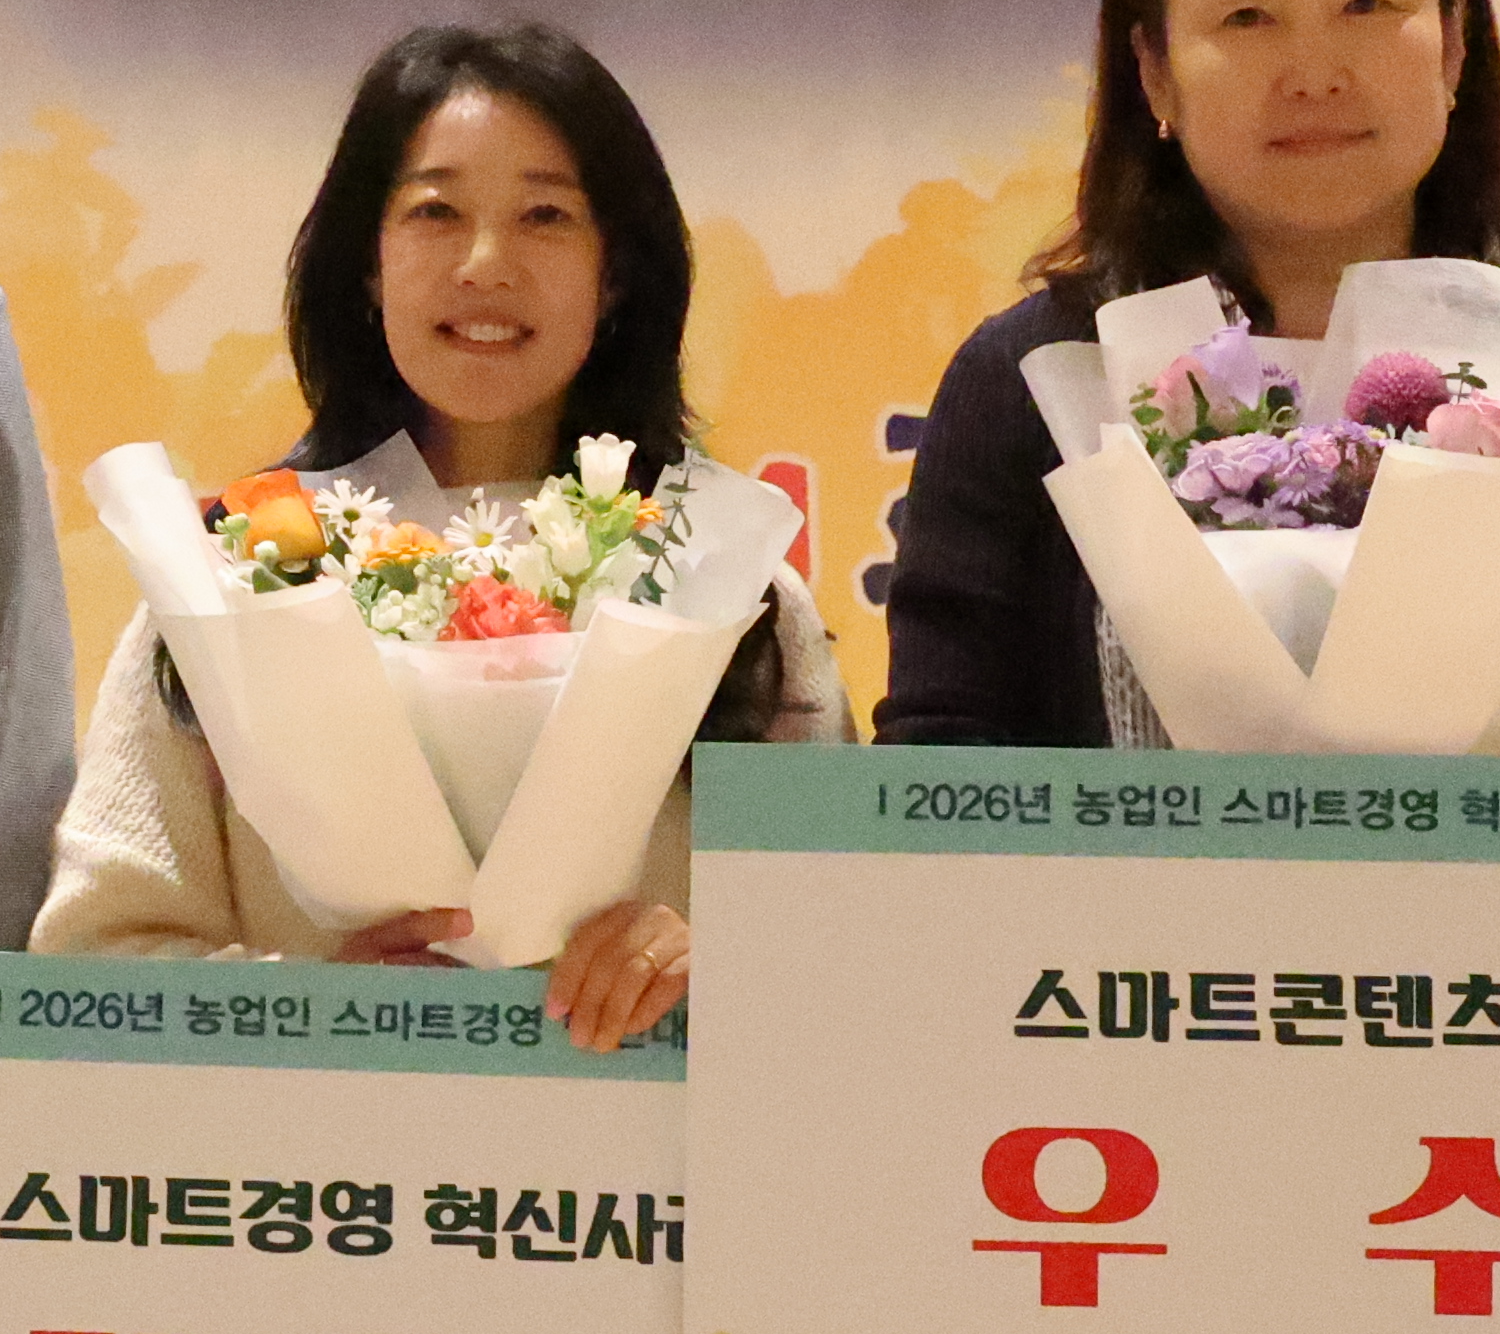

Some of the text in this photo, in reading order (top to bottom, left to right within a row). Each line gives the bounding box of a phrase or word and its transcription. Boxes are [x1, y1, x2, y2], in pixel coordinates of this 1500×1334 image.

[903, 781, 1053, 826] 2026년
[1071, 782, 1202, 828] 농업인
[1219, 785, 1440, 834] 스마트경영
[17, 987, 165, 1034] 2026년
[183, 992, 312, 1039] 농업인
[328, 999, 545, 1049] 스마트경영
[422, 1182, 686, 1266] 혁신사
